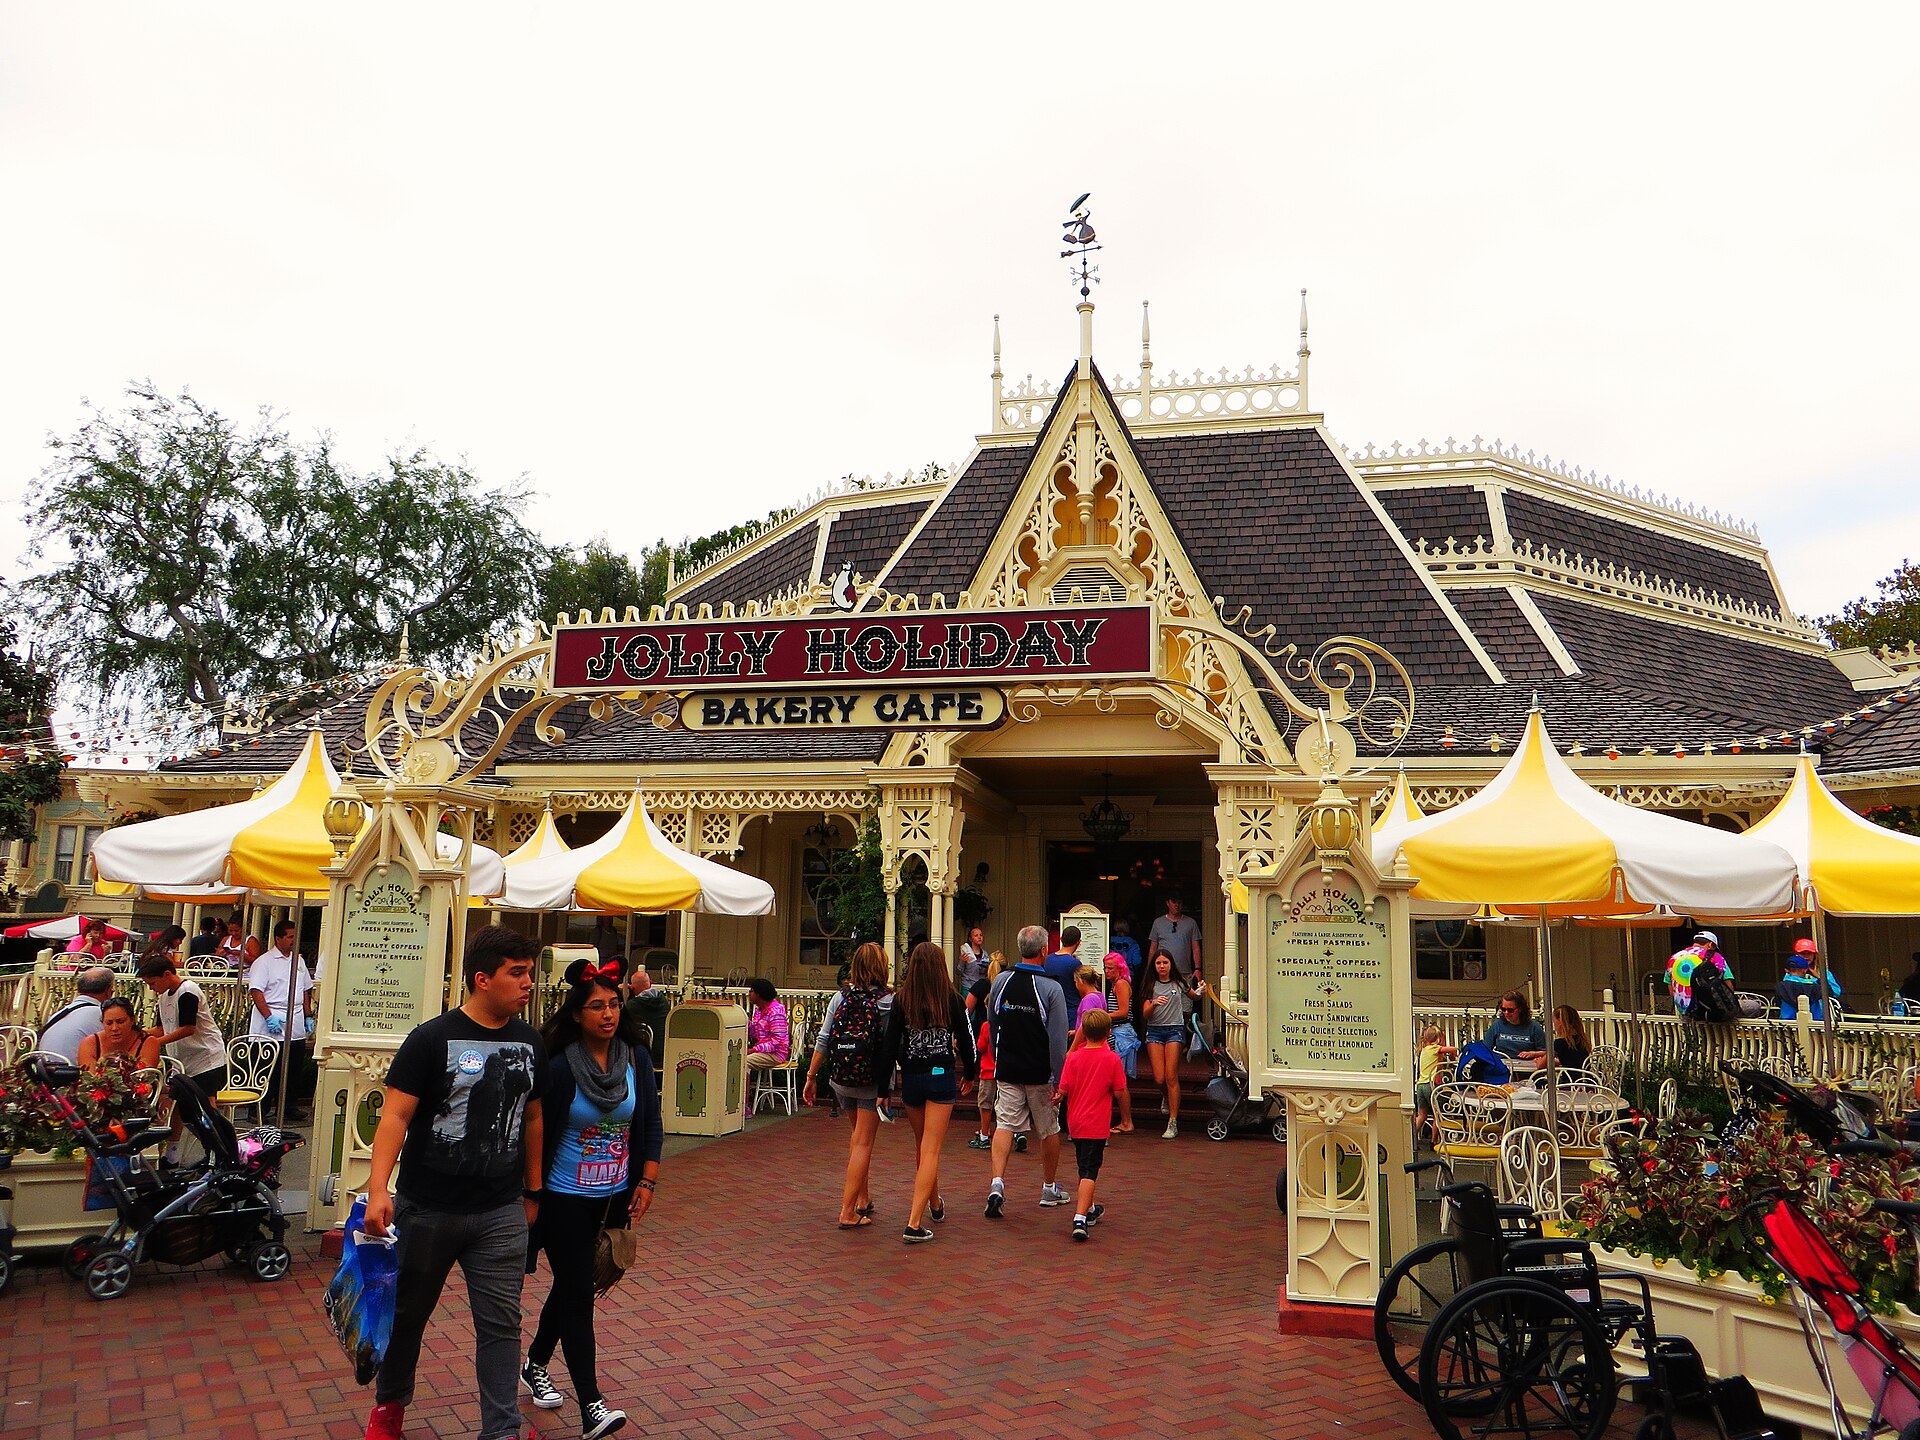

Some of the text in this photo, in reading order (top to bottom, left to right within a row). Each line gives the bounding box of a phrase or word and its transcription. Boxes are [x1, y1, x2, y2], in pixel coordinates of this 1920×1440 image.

[586, 618, 1108, 681] JOLLY HOLIDAY
[702, 692, 983, 725] BAKERY CAFE
[362, 884, 417, 915] JOLLY HOLIDAY
[1290, 888, 1367, 926] JOLLY HOLIDAY
[389, 952, 419, 961] ENTRÉES
[1281, 957, 1331, 965] SPECIALTY
[1281, 969, 1377, 979] SIGNATURE ENTRÉES
[364, 977, 400, 986] FRESH SALADS
[1316, 980, 1342, 992] INCLUDING
[352, 987, 411, 999] SPECIALTY SANDWICHES
[345, 998, 359, 1007] SOUP
[366, 999, 384, 1008] QUICHE
[385, 1000, 415, 1010] SELECTIONS
[1304, 998, 1353, 1009] FRESH SALADS
[347, 1009, 411, 1020] MERRY CHERRY LEMONADE
[1289, 1011, 1370, 1023] SPECIALTY SANDWICHES
[362, 1020, 393, 1030] KID'S MEALS
[1281, 1024, 1378, 1037] SOUP & QUICHE SELECTIONS
[1285, 1037, 1374, 1049] MERRY CHERRY LEMONADE
[1307, 1050, 1351, 1061] KID'S MEALS
